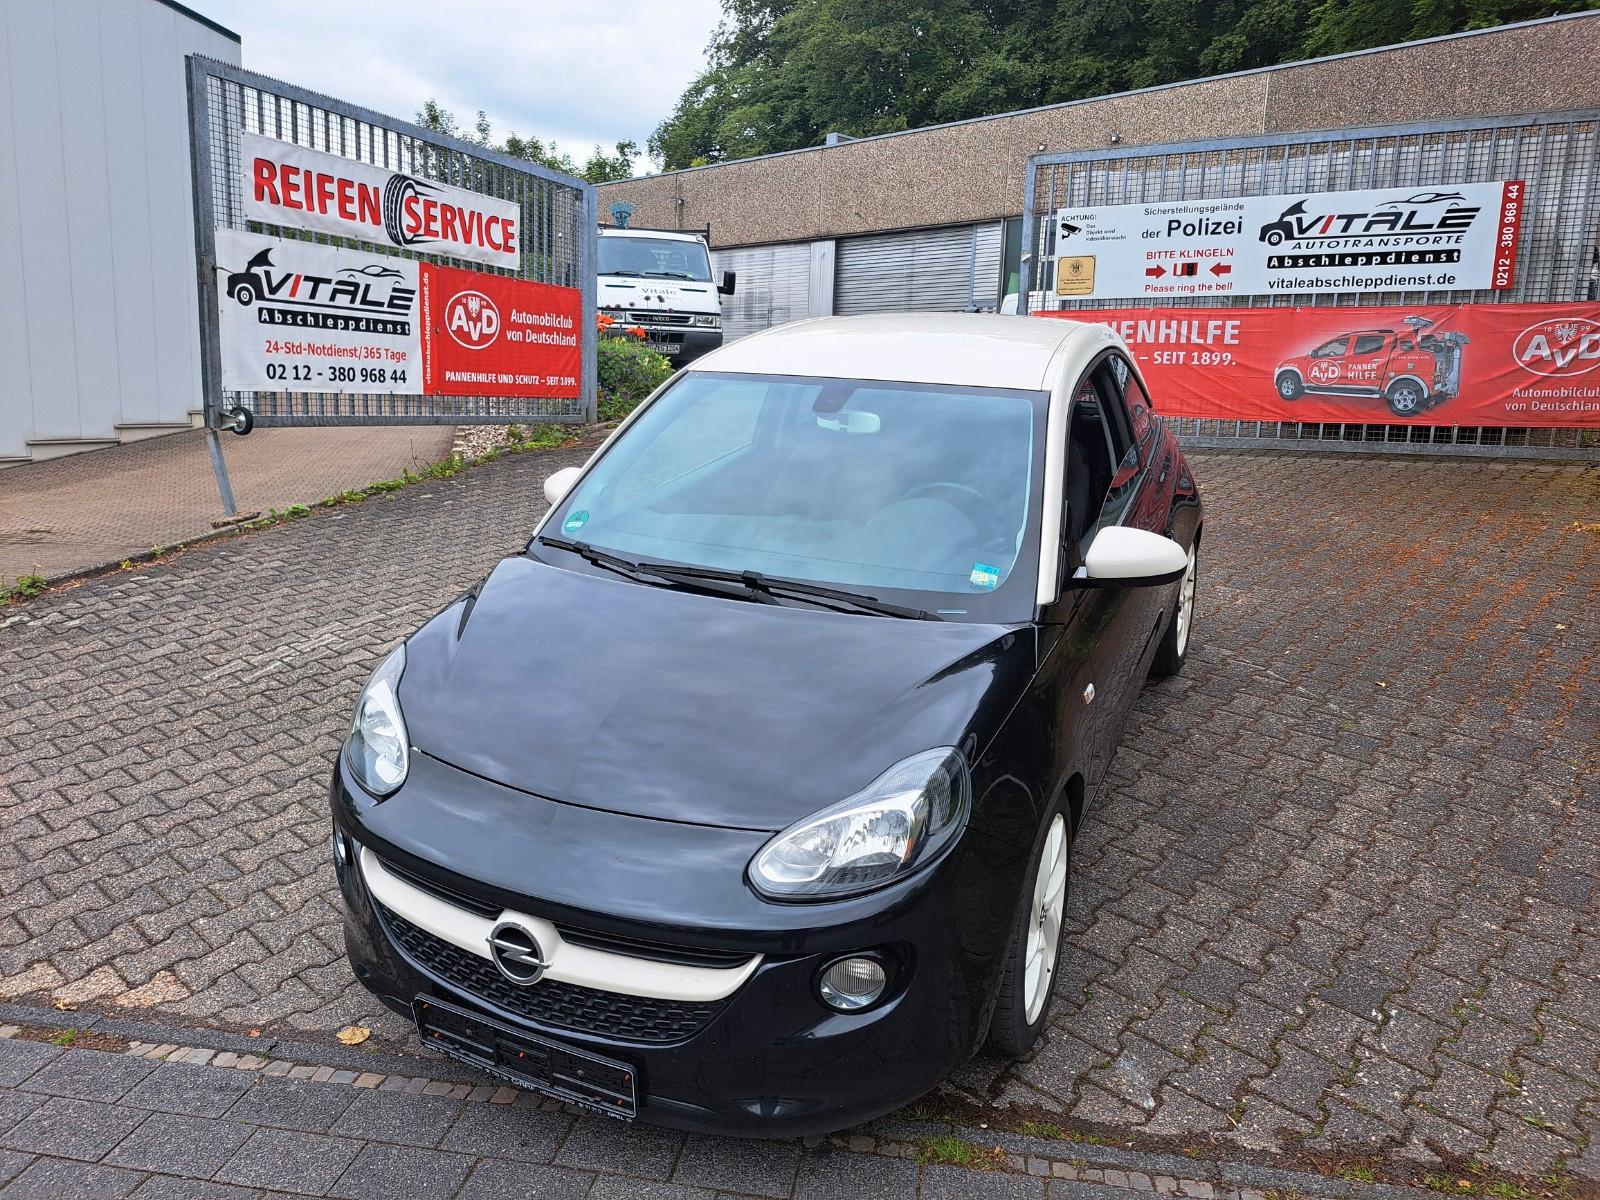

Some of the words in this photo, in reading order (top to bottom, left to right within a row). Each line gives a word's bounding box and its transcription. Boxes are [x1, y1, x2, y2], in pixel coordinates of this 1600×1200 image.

[1507, 184, 1520, 199] 44
[254, 157, 381, 225] REIFEN
[404, 195, 516, 253] SERVICE
[1143, 203, 1245, 216] Sicherstellungsgelände
[1504, 202, 1518, 224] 968
[1061, 214, 1097, 222] ACHTUNG!
[1296, 206, 1482, 235] VITALE
[1141, 229, 1162, 239] der
[1167, 216, 1243, 237] Polizei
[1291, 235, 1465, 250] AUTOTRANSPORTE
[1501, 227, 1514, 247] 380
[1146, 250, 1176, 260] BITTE
[1179, 248, 1234, 258] KLINGELN
[1269, 251, 1460, 268] Abschleppdienst
[1268, 272, 1456, 289] vitaleabschleppdienst.de
[1496, 258, 1511, 286] 0212
[264, 270, 416, 310] VITALE
[641, 287, 677, 295] Vitale
[1144, 284, 1175, 293] Please
[1177, 283, 1196, 294] ring
[1198, 282, 1213, 291] the
[1215, 282, 1233, 291] bell
[261, 309, 410, 335] Abschleppdienst
[510, 309, 573, 329] Automobilclub
[423, 272, 431, 385] vitaleabschleppdienst.de
[506, 330, 523, 341] von
[525, 329, 576, 346] Deutschland
[265, 340, 381, 360] 24-Std-Notdienst/365
[385, 349, 407, 363] Tage
[1153, 351, 1187, 365] SEIT
[1191, 352, 1236, 365] 1899.
[266, 363, 286, 380] 02
[292, 365, 312, 380] 12
[328, 366, 355, 382] 380
[360, 368, 386, 383] 968
[390, 369, 407, 384] 44
[445, 370, 497, 382] PANNENHILFE
[498, 375, 514, 384] UND
[515, 375, 540, 385] SCHUTZ
[546, 376, 559, 385] SEIT
[560, 377, 577, 386] 1899.
[1347, 371, 1377, 380] HILFE
[1505, 402, 1526, 411] von
[1531, 401, 1600, 411] Deutschlan
